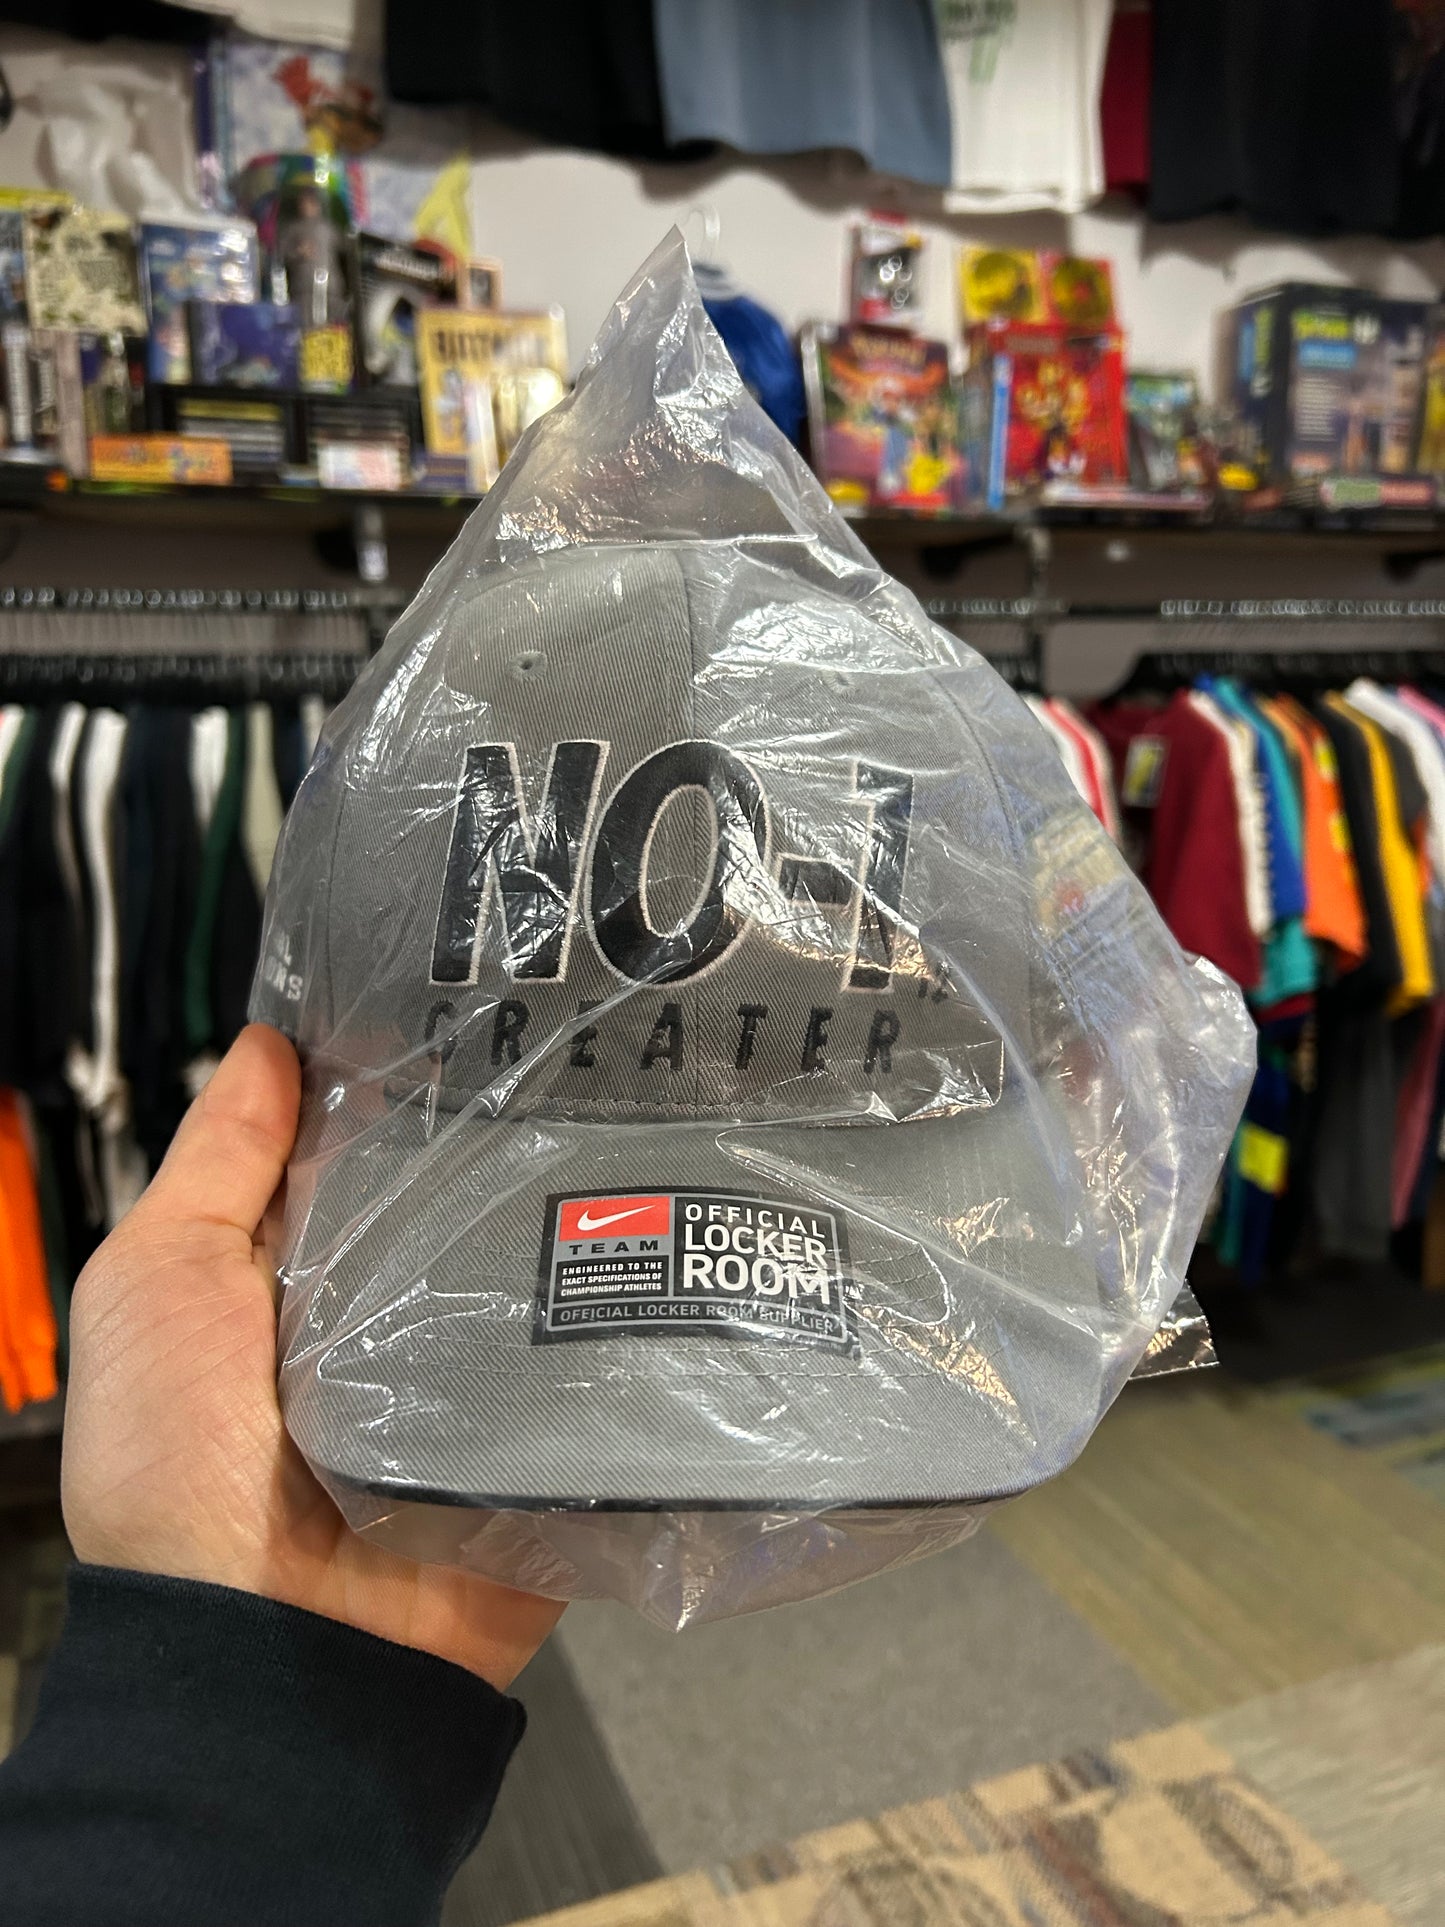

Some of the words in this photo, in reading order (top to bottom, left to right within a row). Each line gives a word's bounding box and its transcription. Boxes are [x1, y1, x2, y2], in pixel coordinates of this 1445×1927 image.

[685, 1203, 826, 1239] OFFICIAL
[568, 1240, 659, 1255] TEAM
[685, 1223, 828, 1268] LOCKER
[562, 1263, 624, 1275] ENGINEERED
[628, 1262, 640, 1271] TO
[644, 1261, 663, 1270] THE
[560, 1284, 623, 1297] CHAMPIONSHIP
[623, 1282, 662, 1291] ATHLETES
[561, 1276, 587, 1286] EXACT
[587, 1273, 651, 1284] SPECIFICATIONS
[651, 1272, 663, 1280] OF
[683, 1253, 831, 1305] ROOM
[560, 1306, 633, 1322] OFFICIAL
[638, 1304, 700, 1316] LOCKER
[706, 1305, 753, 1319] ROOM
[759, 1307, 834, 1332] SUPPLIER
